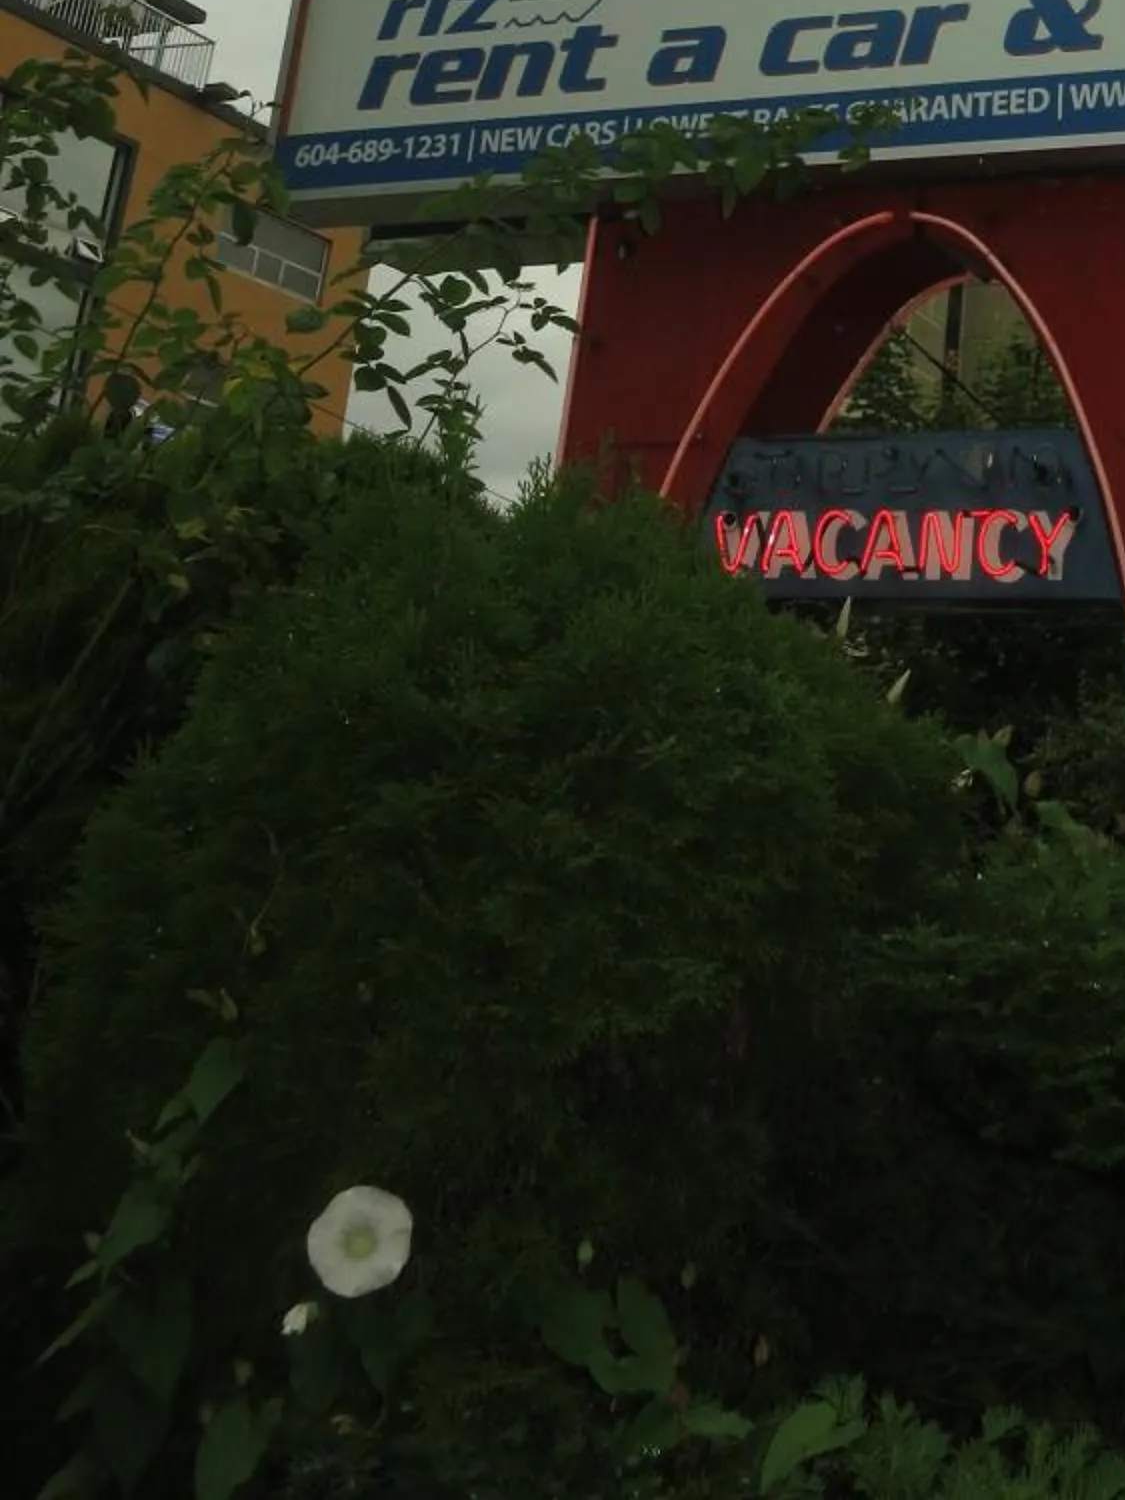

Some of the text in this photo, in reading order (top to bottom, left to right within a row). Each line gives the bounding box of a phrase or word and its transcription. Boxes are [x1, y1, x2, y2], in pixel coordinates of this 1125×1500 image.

[356, 23, 619, 111] rent
[645, 24, 727, 87] a
[758, 2, 972, 77] car
[294, 132, 462, 169] 604-689-1231
[479, 125, 545, 155] NEW
[546, 119, 619, 150] CARS
[714, 506, 1079, 583] VACANCY
